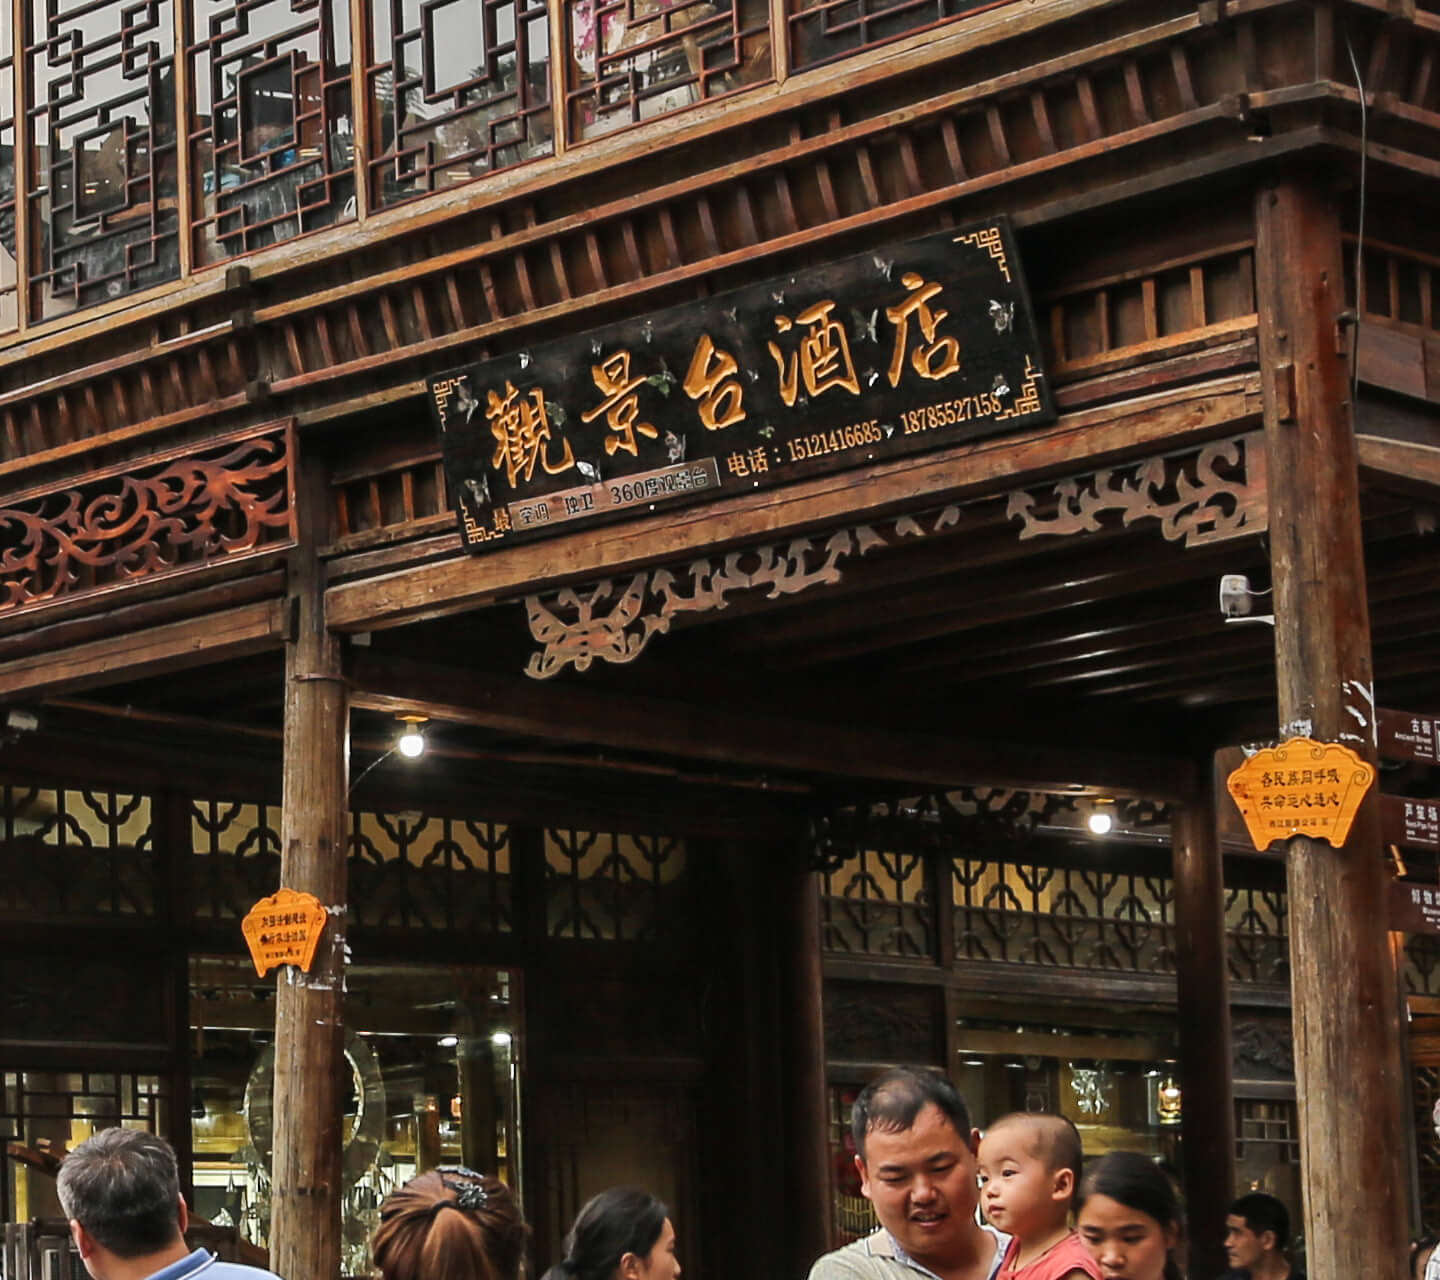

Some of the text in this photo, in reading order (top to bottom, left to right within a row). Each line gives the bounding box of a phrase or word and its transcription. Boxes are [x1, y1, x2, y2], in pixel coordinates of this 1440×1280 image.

[485, 272, 961, 489] 觀景台酒店
[787, 419, 882, 462] 15121416685
[900, 391, 1003, 435] 18785527158
